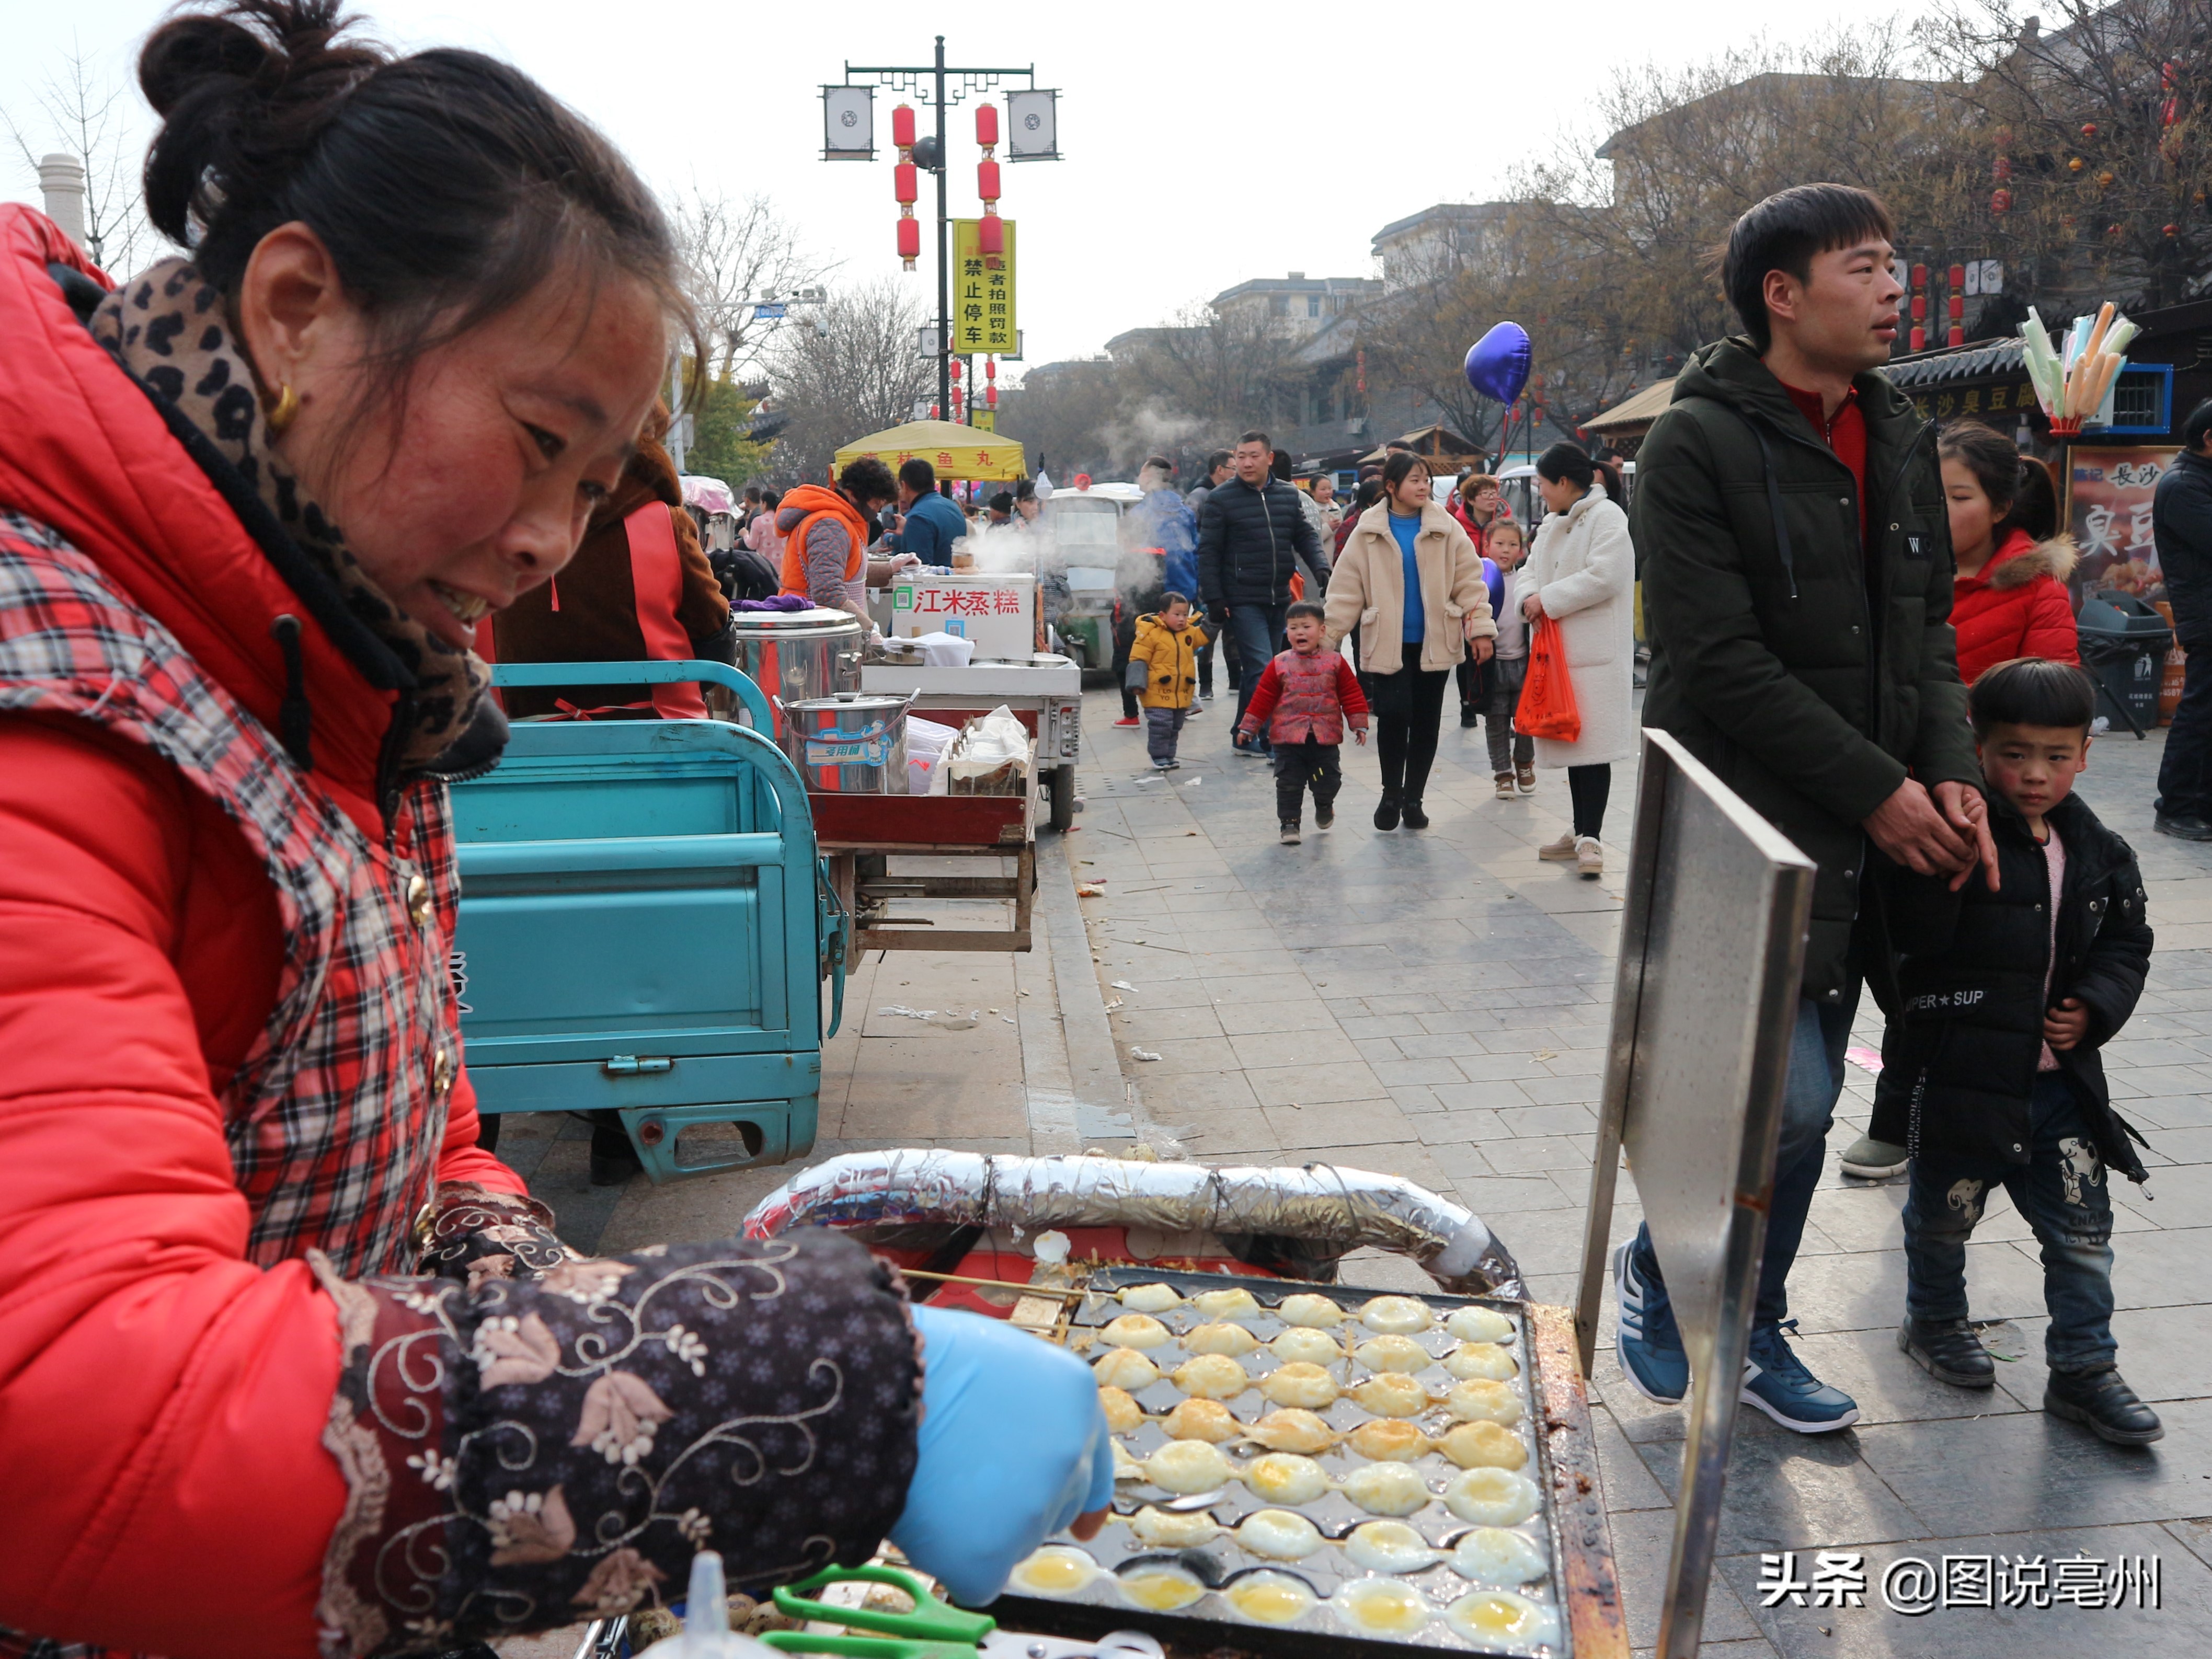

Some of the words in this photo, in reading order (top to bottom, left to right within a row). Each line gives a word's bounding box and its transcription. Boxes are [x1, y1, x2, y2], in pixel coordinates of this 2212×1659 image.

[964, 259, 982, 343] 禁止停车
[1916, 382, 2036, 418] 长沙臭豆腐
[2111, 465, 2160, 486] 長沙
[913, 589, 1019, 616] 江米蒸糕
[825, 745, 860, 756] 多用桶
[1954, 990, 1985, 1006] SUP
